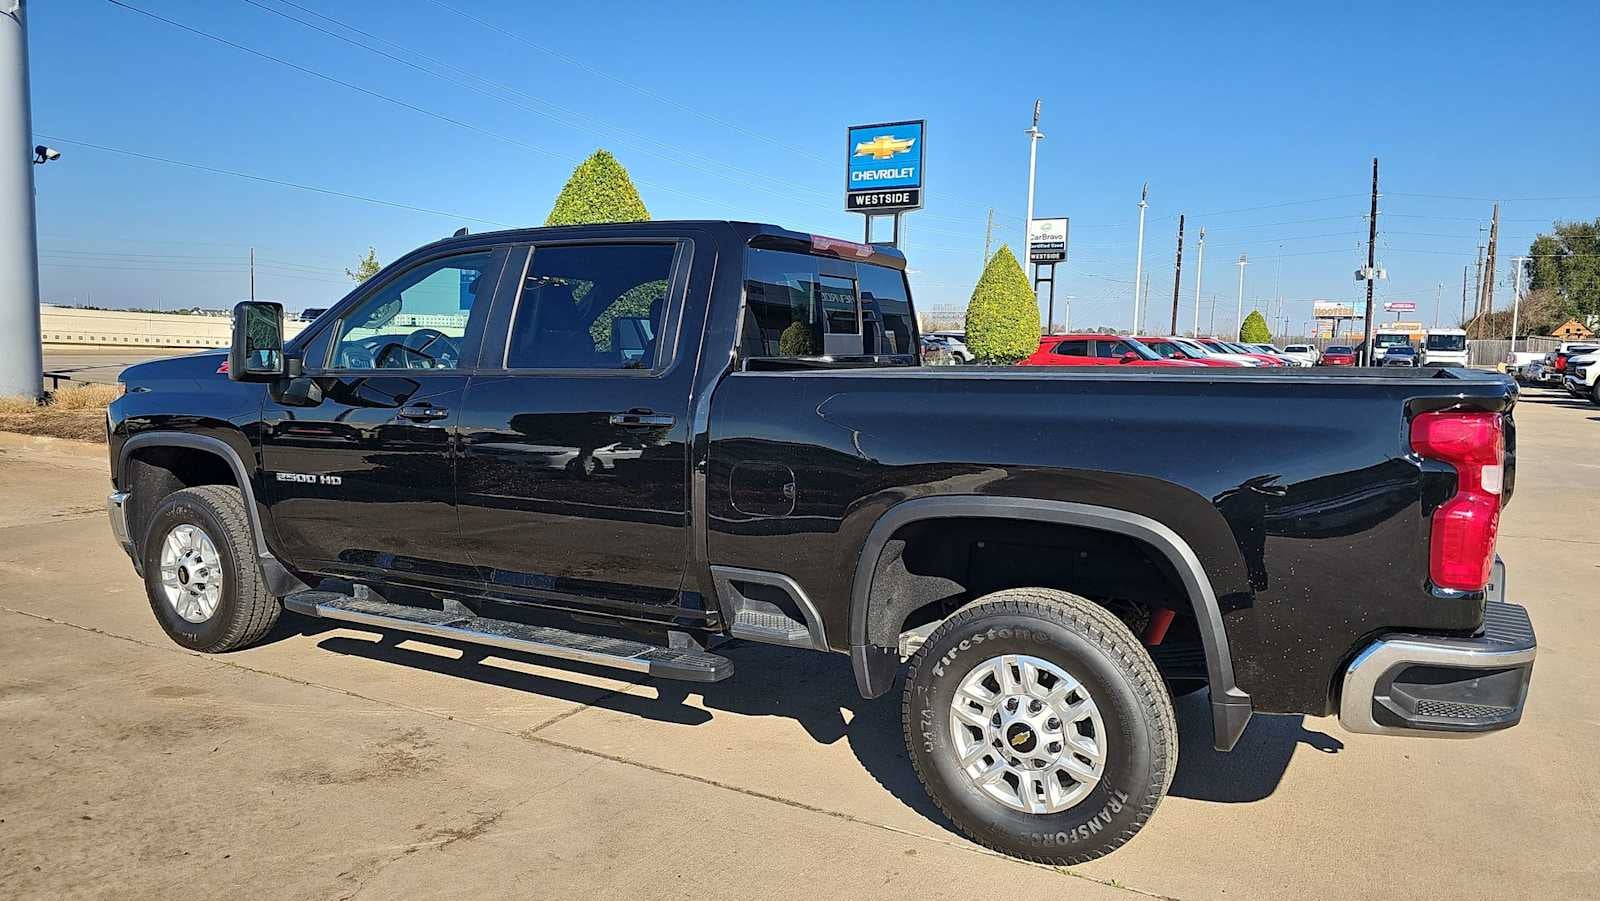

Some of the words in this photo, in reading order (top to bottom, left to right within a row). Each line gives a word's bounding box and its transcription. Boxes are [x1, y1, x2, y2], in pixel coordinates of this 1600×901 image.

[852, 167, 915, 181] CHEVROLET
[855, 192, 910, 205] WESTSIDE
[276, 472, 317, 483] 2500
[320, 475, 342, 485] HD
